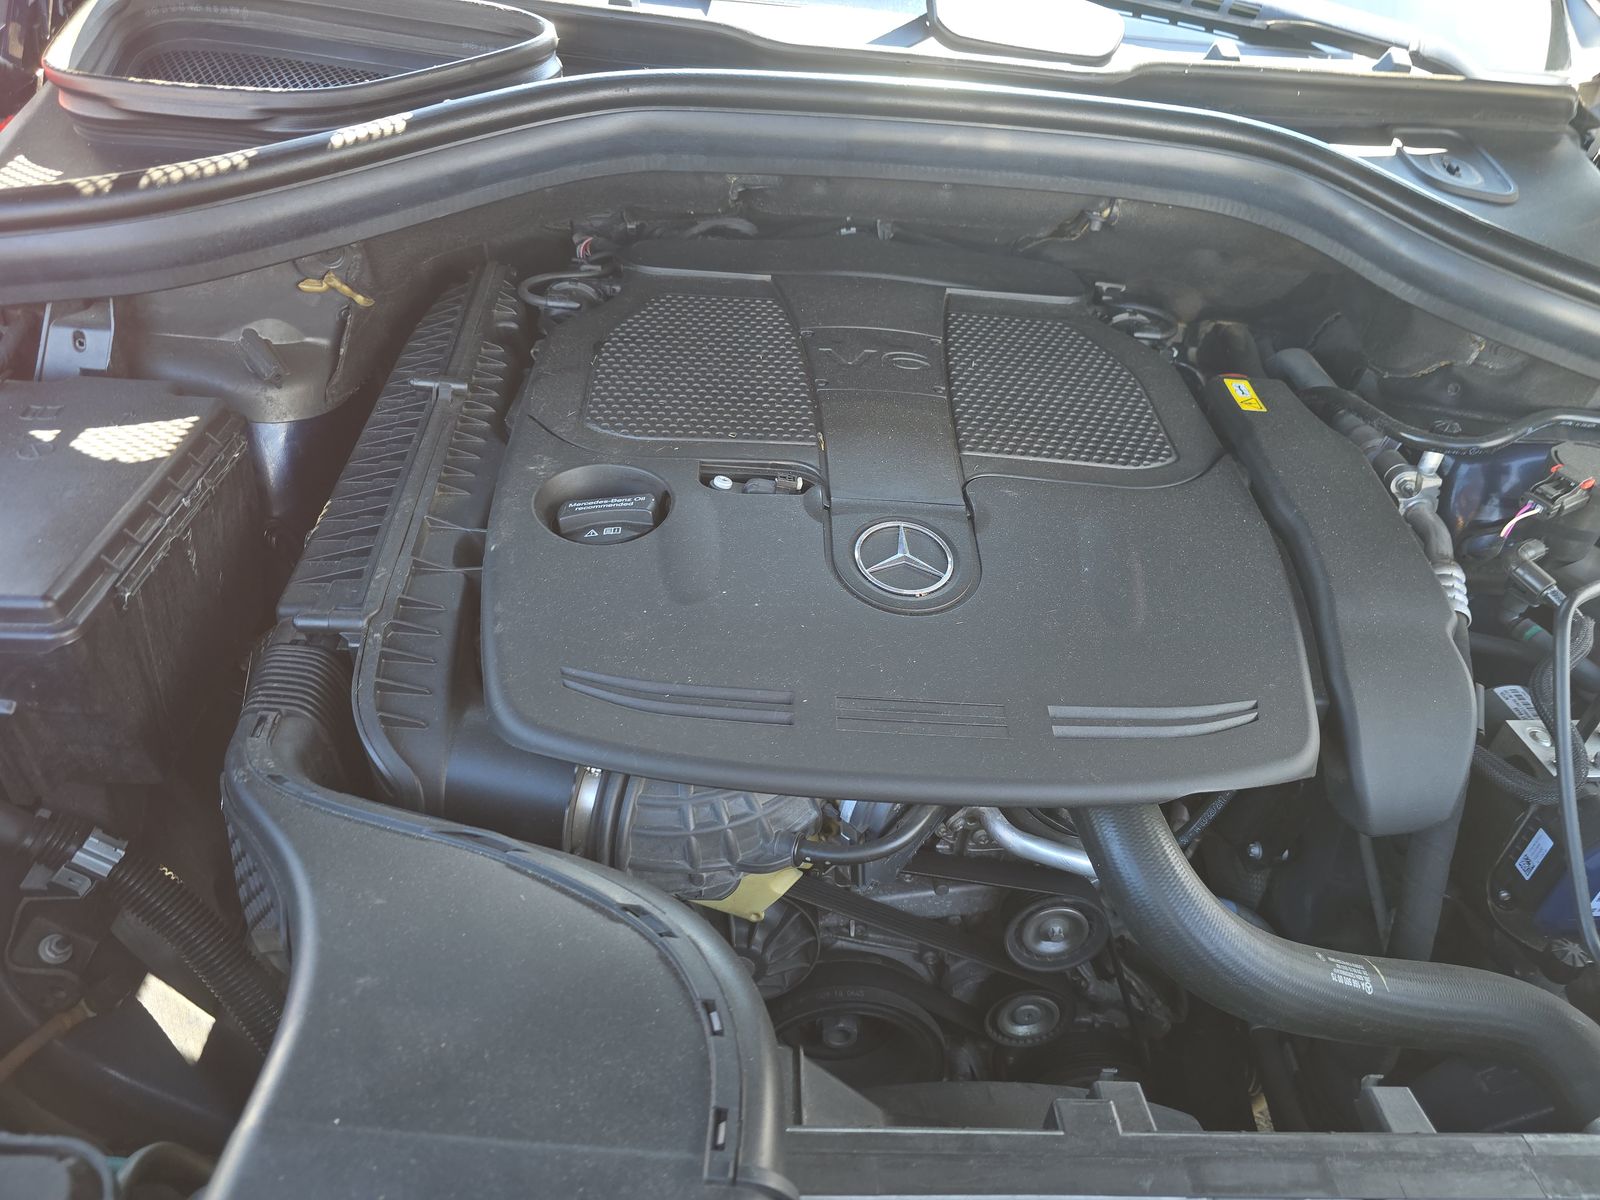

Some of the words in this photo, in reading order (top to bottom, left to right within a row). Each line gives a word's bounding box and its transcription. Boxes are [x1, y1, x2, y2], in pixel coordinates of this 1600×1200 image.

[818, 347, 931, 371] V6
[568, 497, 633, 508] Mercedes-Benz
[574, 501, 634, 511] recommended
